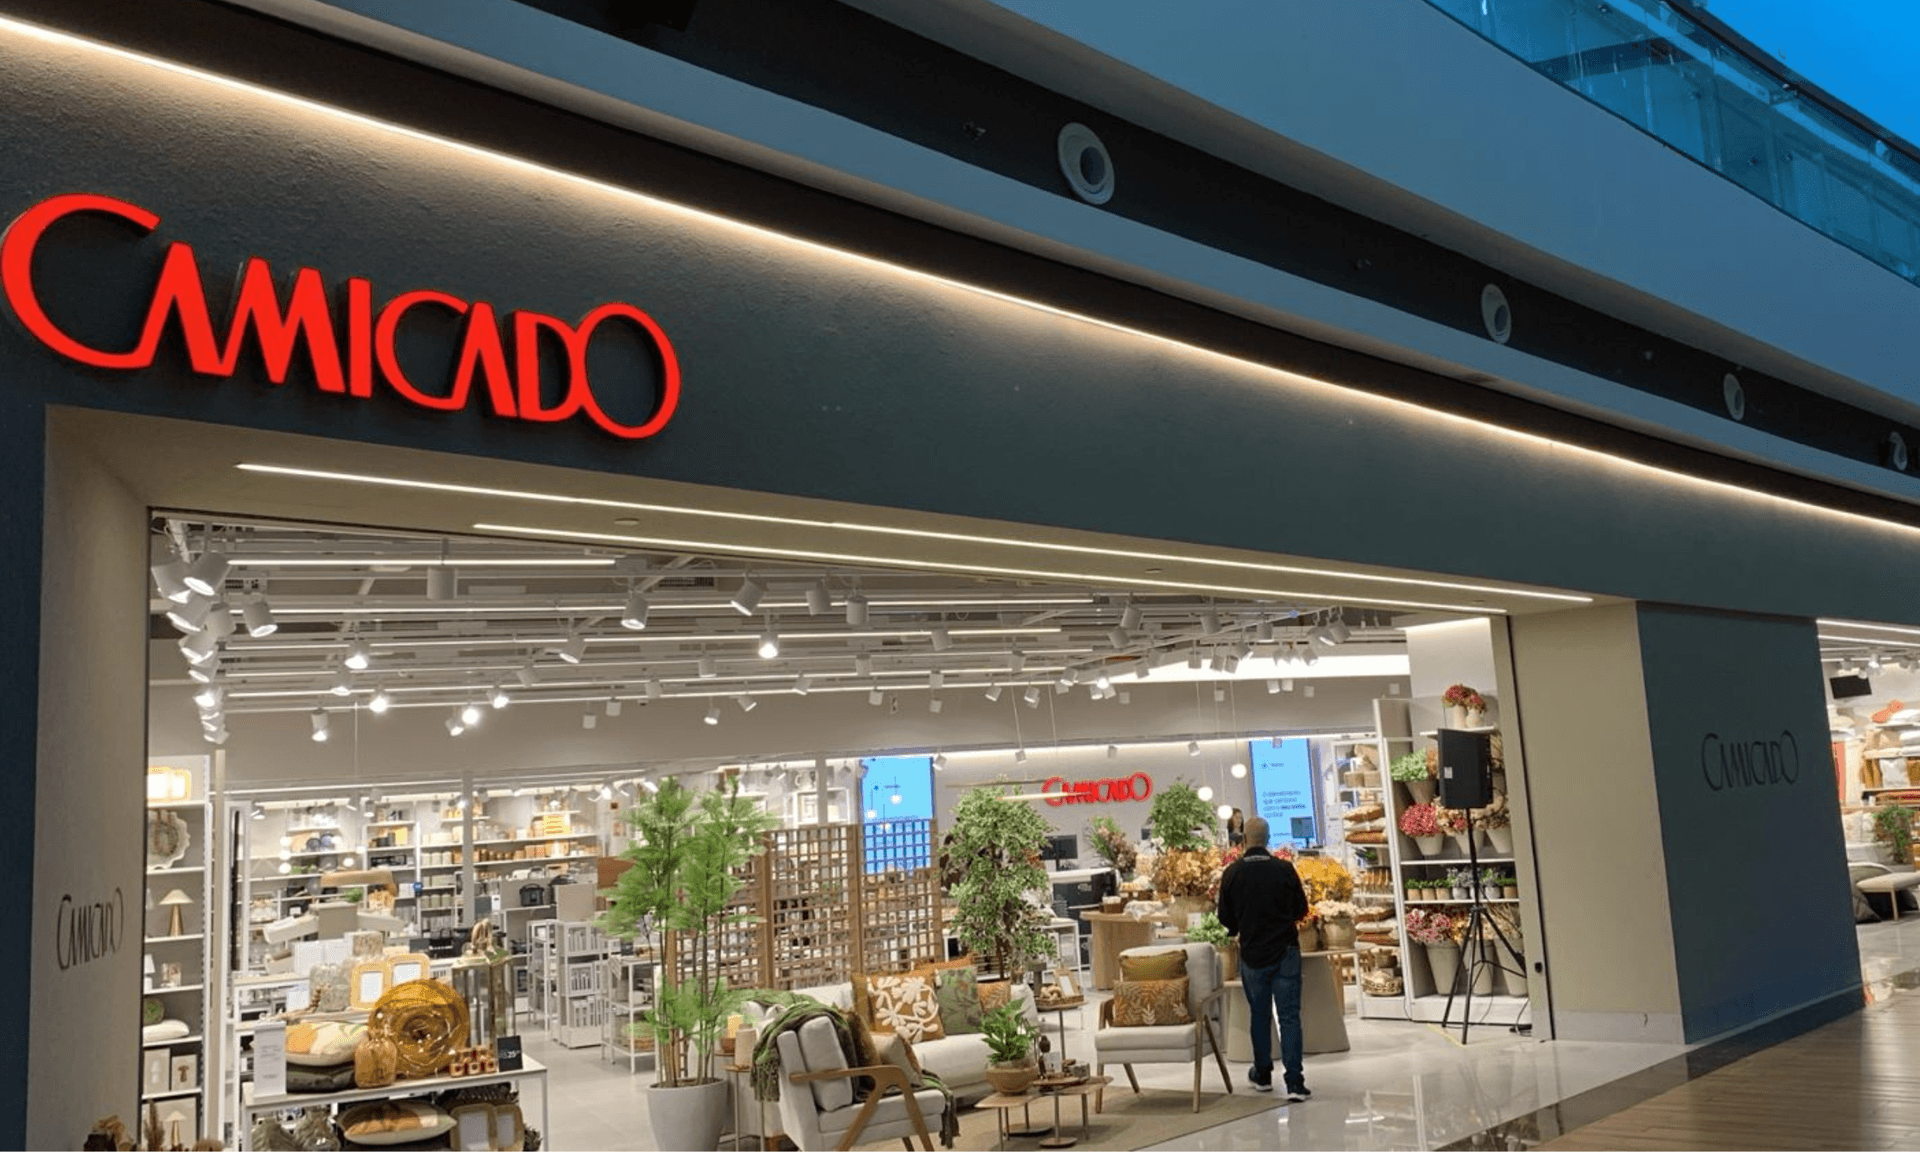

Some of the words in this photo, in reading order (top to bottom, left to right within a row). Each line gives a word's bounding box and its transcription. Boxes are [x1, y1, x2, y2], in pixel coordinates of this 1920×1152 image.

[1, 193, 681, 439] CAMICADO
[1701, 730, 1799, 792] CAMICADO
[56, 887, 124, 971] CAMICADO
